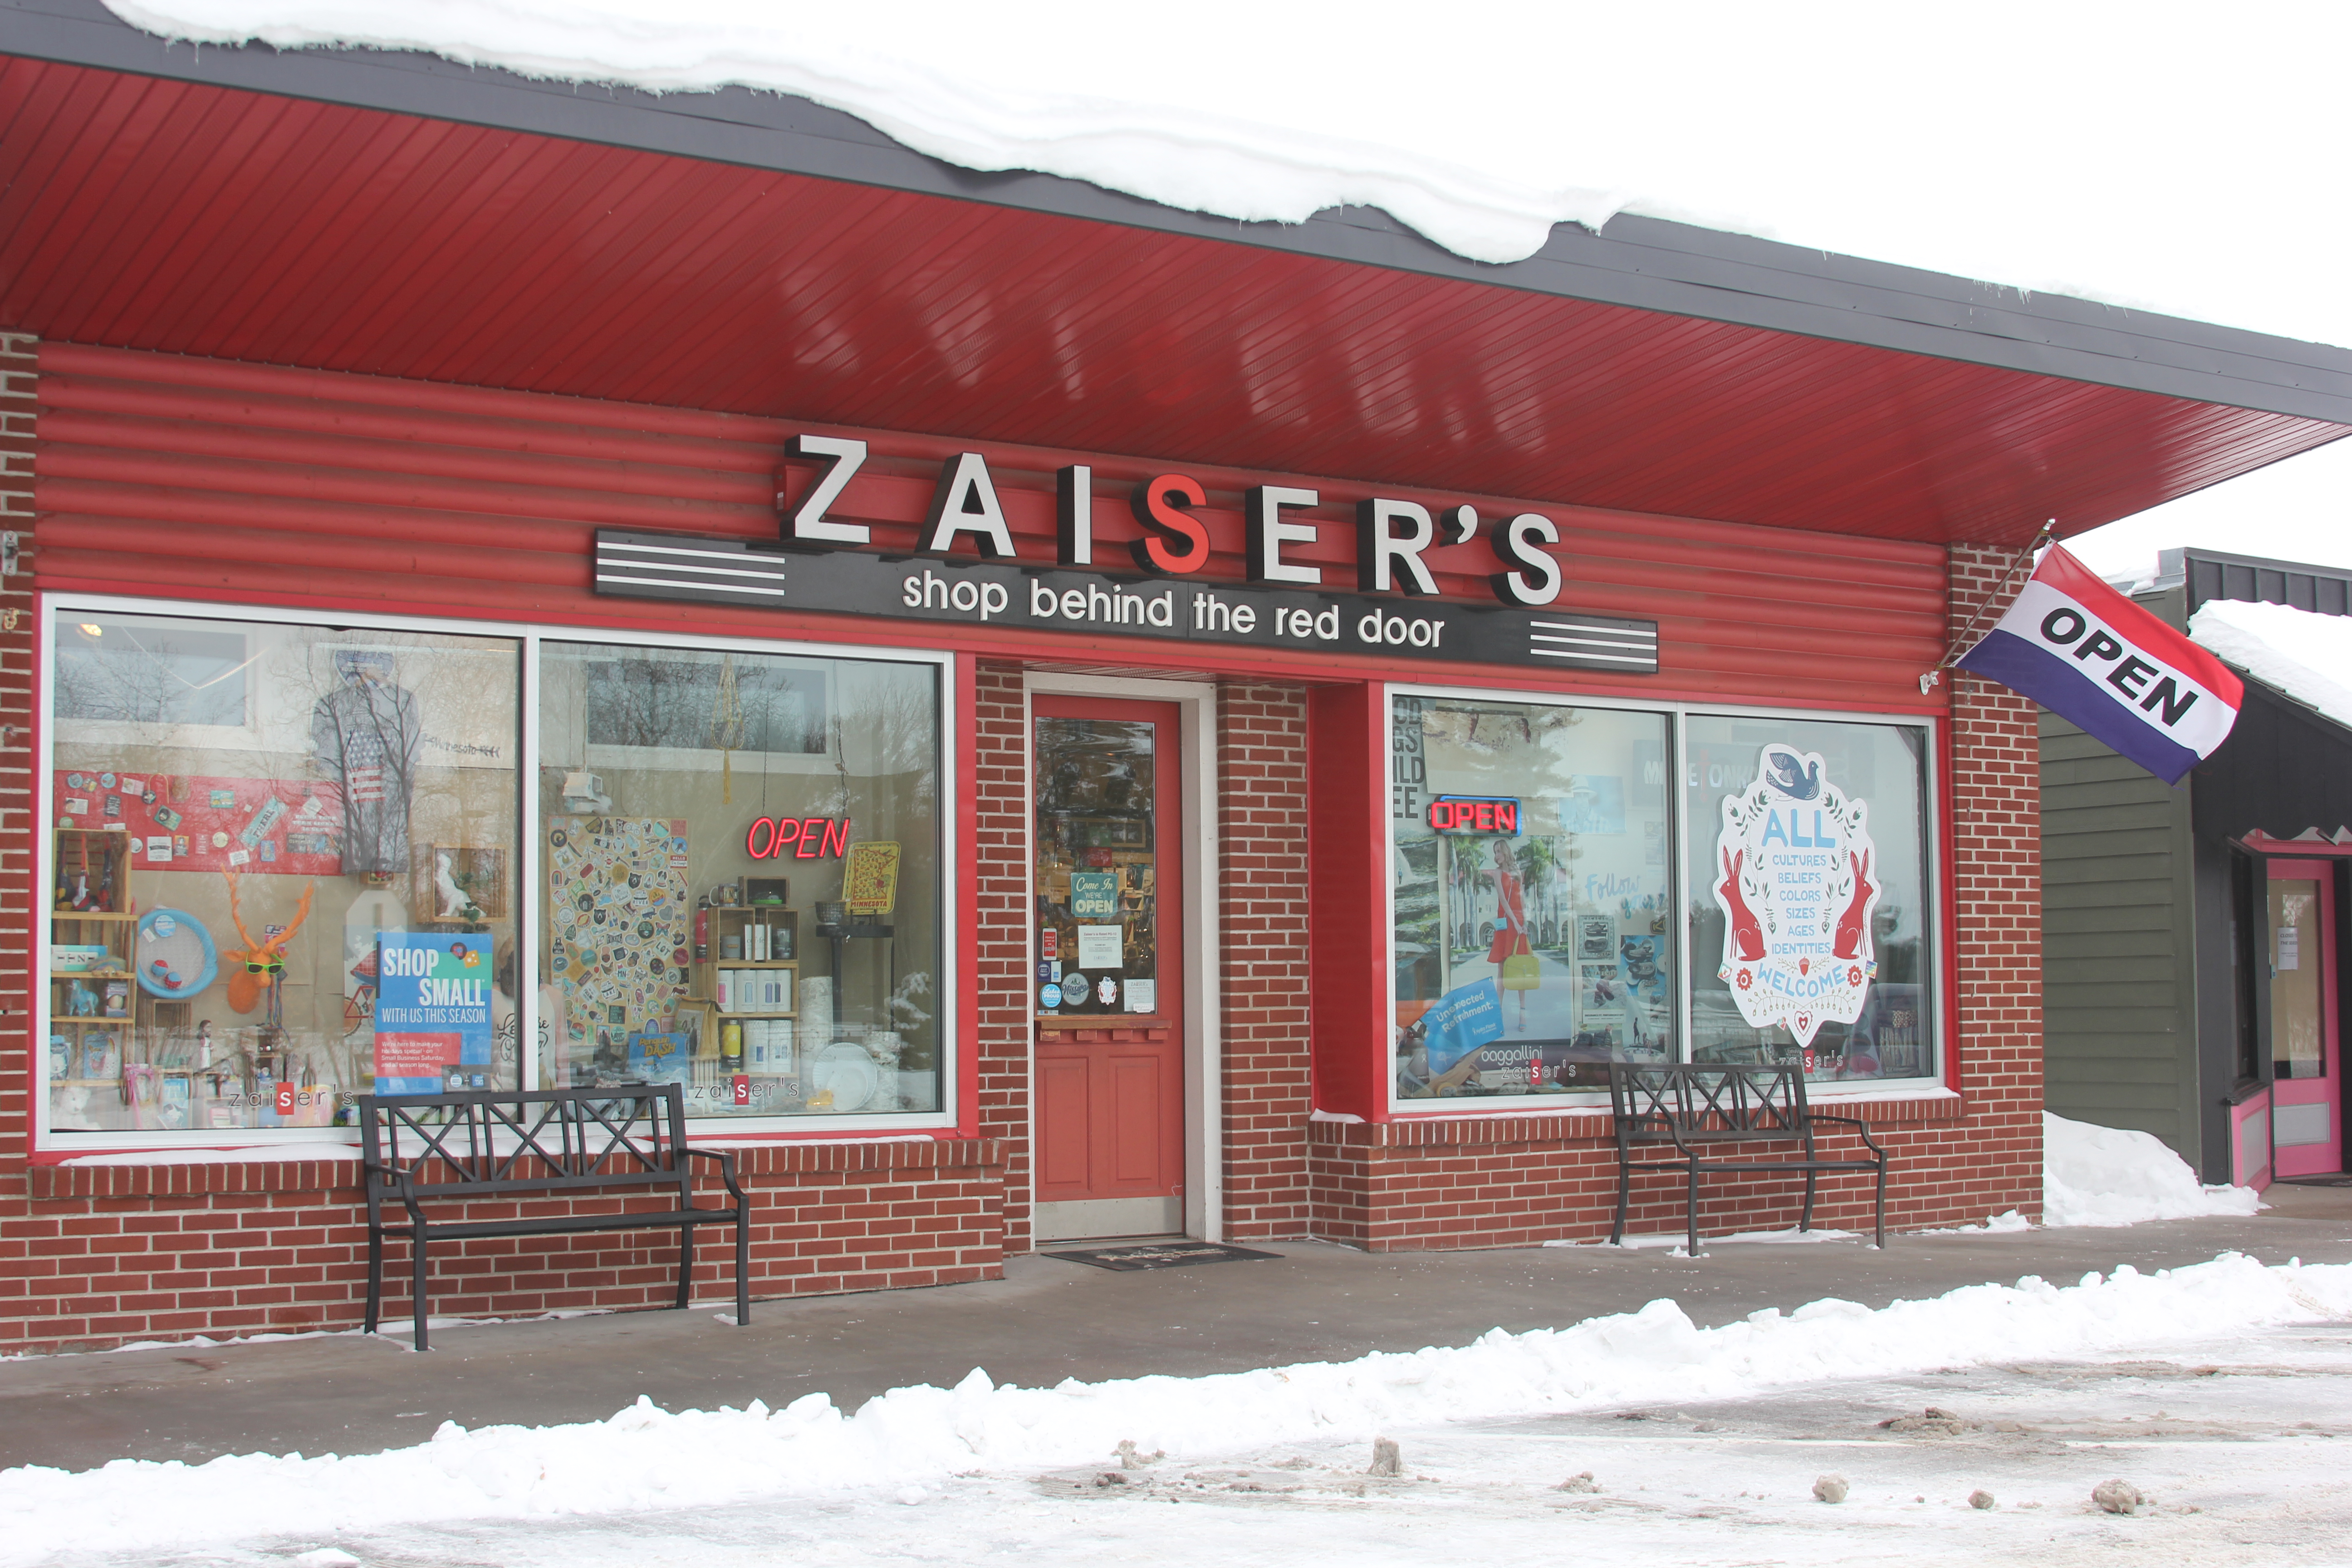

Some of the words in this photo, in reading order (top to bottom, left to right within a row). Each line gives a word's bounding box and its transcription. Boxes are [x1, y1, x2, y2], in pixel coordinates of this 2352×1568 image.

[781, 434, 1562, 606] ZAISER'S
[902, 569, 1009, 621] shop
[1030, 578, 1173, 627] behind
[1192, 592, 1256, 634] the
[1275, 604, 1339, 640] red
[1357, 608, 1445, 648] door
[2040, 608, 2200, 727] OPEN
[1431, 802, 1516, 830] OPEN
[746, 816, 851, 860] OPEN
[1761, 808, 1836, 848] ALL
[1772, 854, 1827, 867] CULTURES
[1076, 877, 1099, 892] Come
[1101, 877, 1114, 890] In
[1585, 872, 1641, 902] Follow
[1778, 872, 1821, 884] BELIEFS
[1075, 899, 1113, 913] OPEN
[1779, 890, 1821, 902] COLORS
[1785, 907, 1815, 919] SIZES
[1787, 925, 1815, 937] AGES
[1771, 942, 1831, 955] IDENTITIES
[383, 948, 439, 976] SHOP
[1757, 962, 1846, 998] WELCOME
[419, 978, 485, 1006] SMALL
[603, 989, 616, 998] LAKE
[382, 1008, 407, 1023] WITH
[410, 1008, 423, 1023] US
[425, 1008, 447, 1023] THIS
[449, 1008, 486, 1023] SEASON
[638, 1036, 670, 1046] Penguin
[644, 1042, 676, 1058] DASH
[1501, 1059, 1576, 1079] zaiser's
[229, 1083, 353, 1107] zaiser's
[694, 1076, 799, 1098] zaiser's
